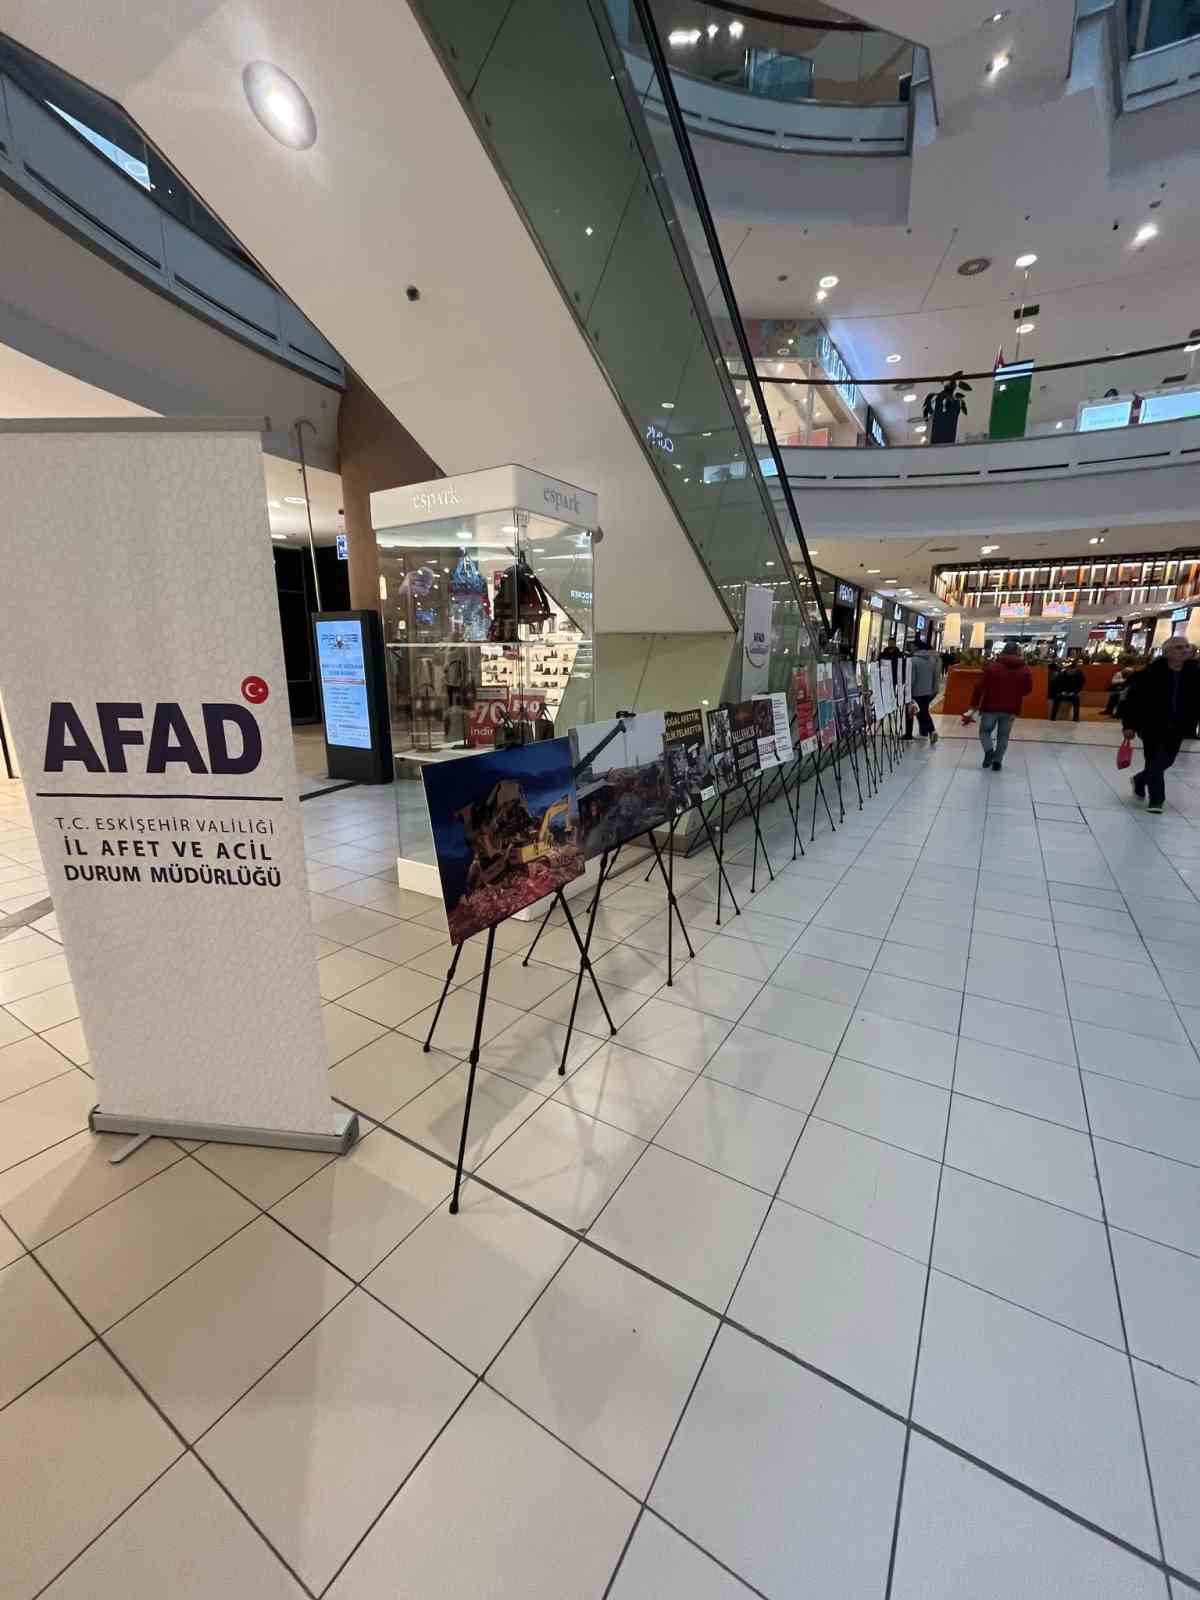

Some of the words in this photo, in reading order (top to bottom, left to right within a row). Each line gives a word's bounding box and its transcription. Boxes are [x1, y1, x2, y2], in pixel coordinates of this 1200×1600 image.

[412, 485, 458, 512] espark
[543, 488, 580, 513] espark
[43, 702, 262, 774] AFAD
[56, 817, 89, 830] T.C.
[96, 816, 190, 834] ESKİŞEHİR
[197, 818, 274, 835] VALİLİĞİ
[64, 836, 88, 856] İL
[101, 840, 159, 857] AFET
[172, 841, 203, 858] VE
[216, 841, 271, 860] ACİL
[64, 865, 141, 882] DURUM
[151, 866, 281, 886] MÜDÜRLÜĞÜ
